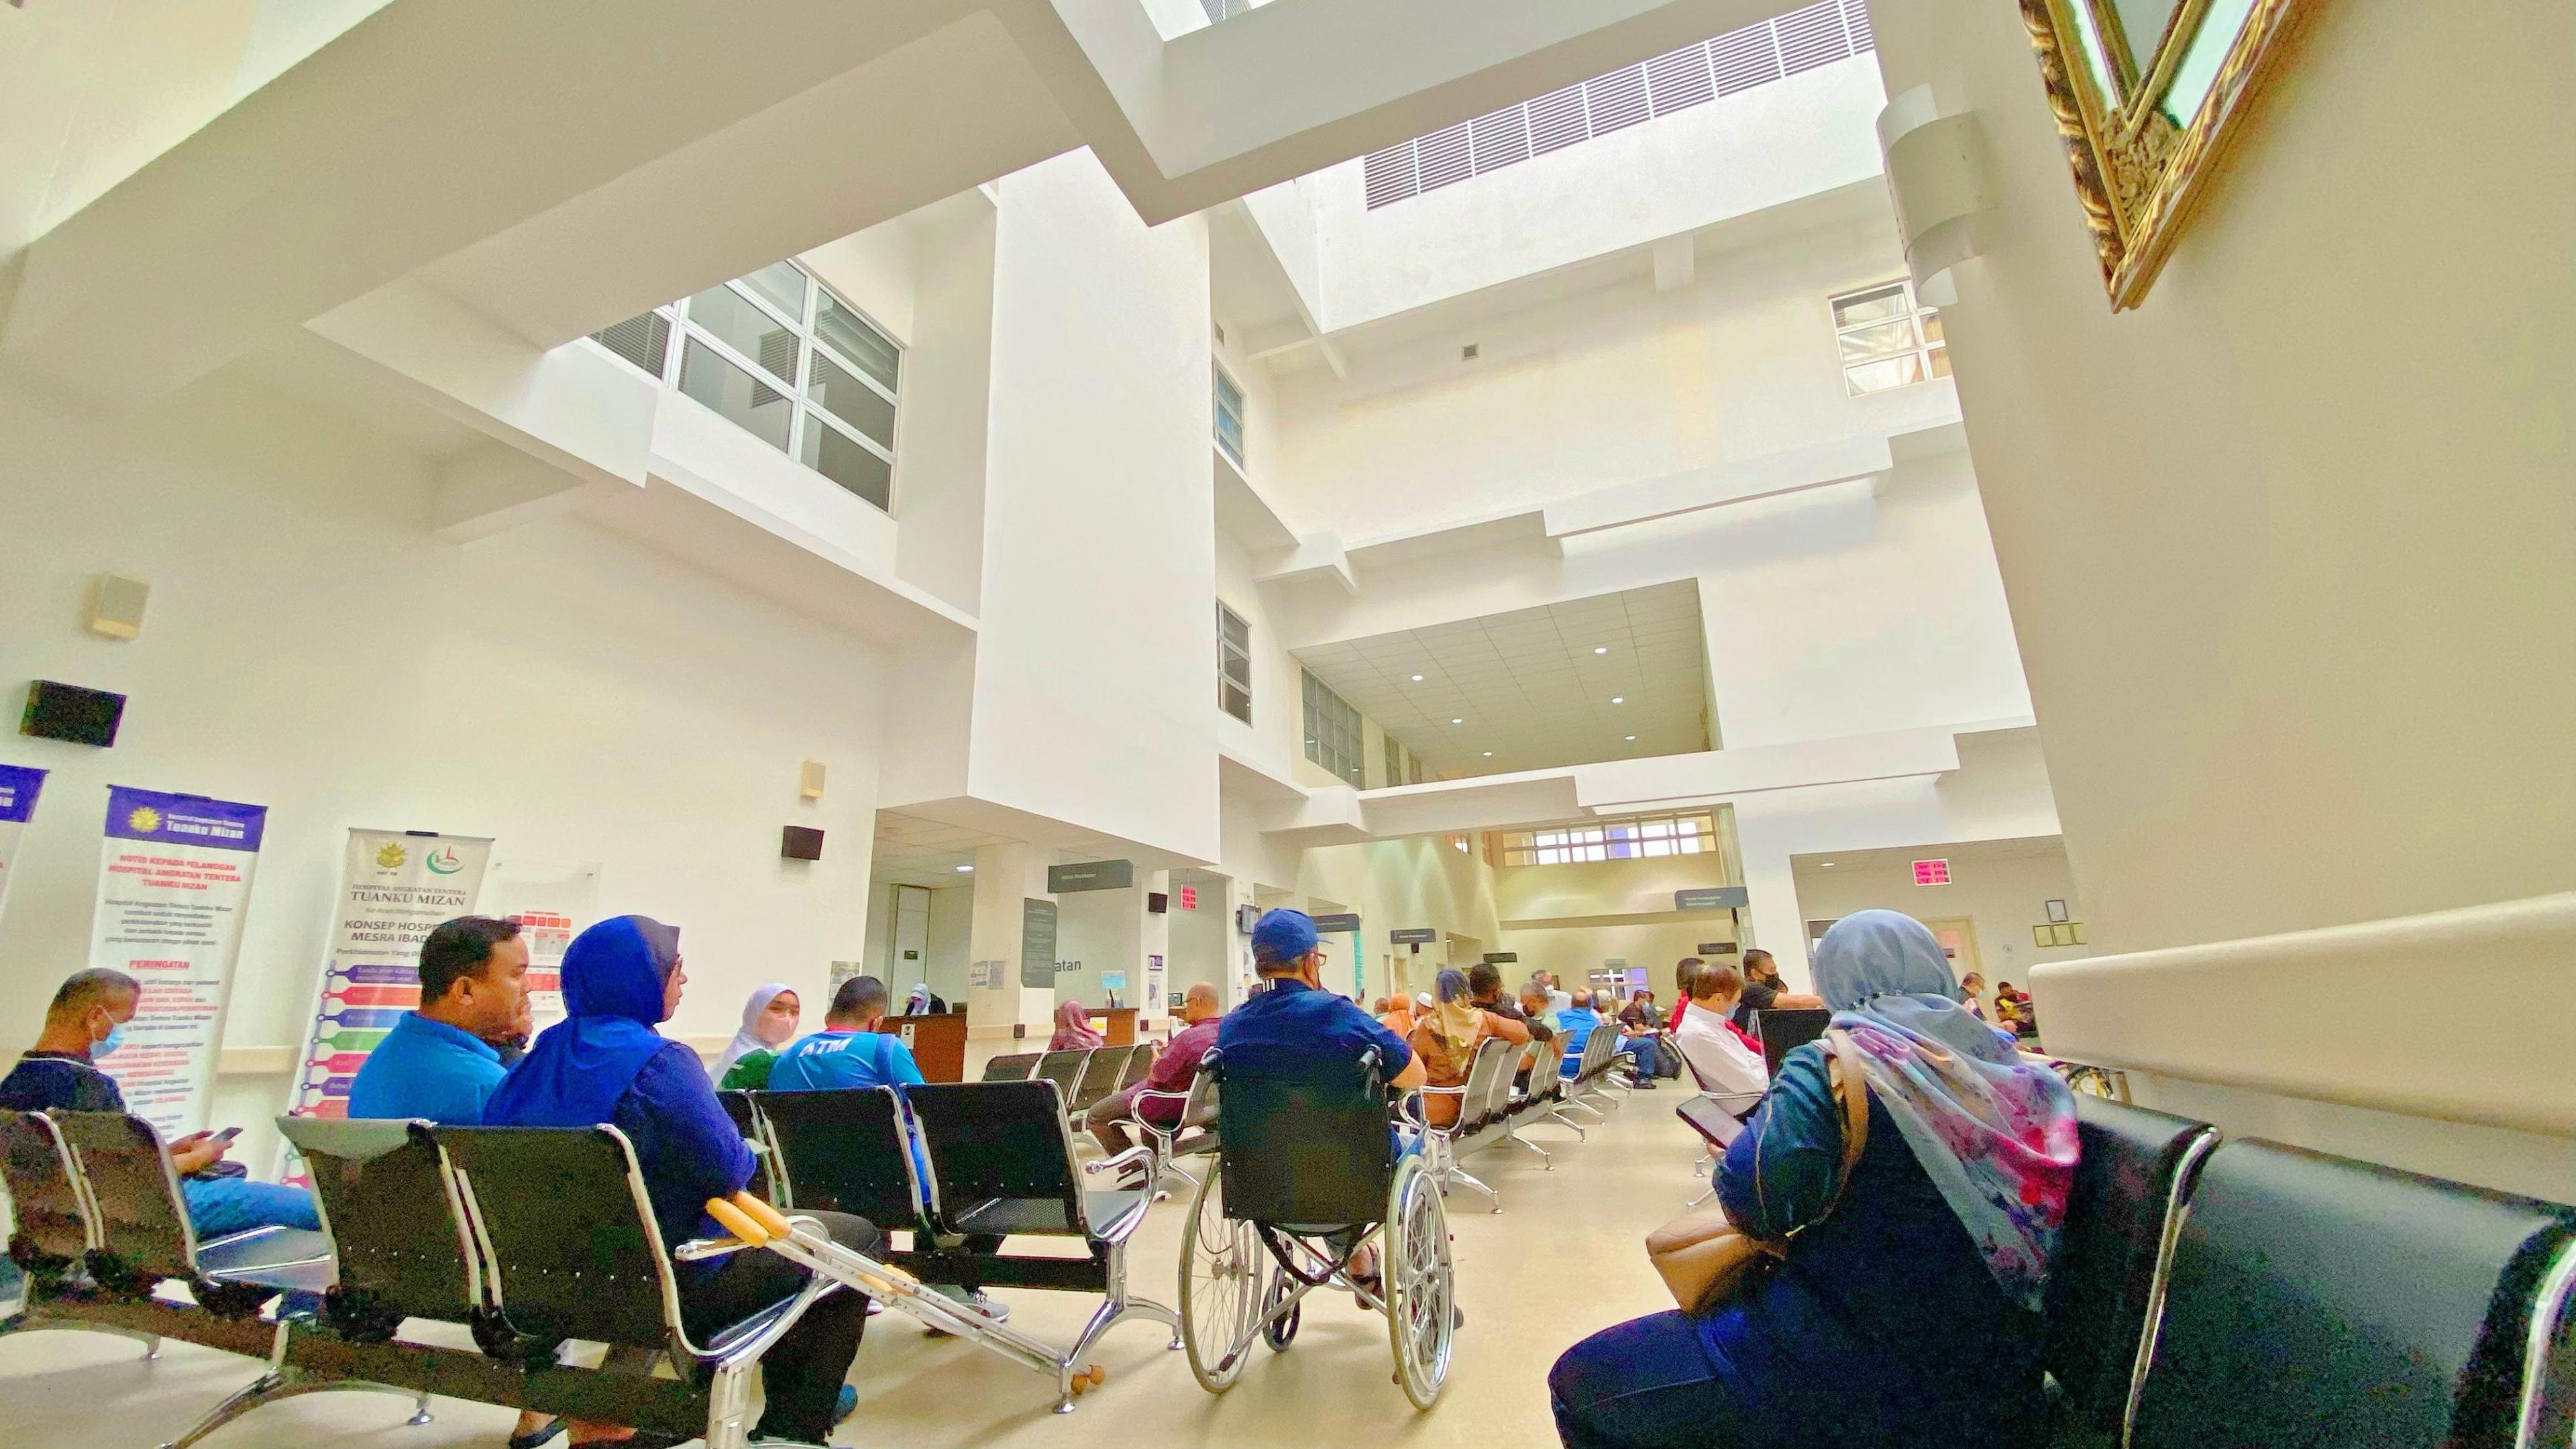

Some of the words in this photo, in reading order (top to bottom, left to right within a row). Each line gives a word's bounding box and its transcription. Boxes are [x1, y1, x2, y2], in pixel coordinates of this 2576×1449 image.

[109, 865, 153, 875] HOSPITAL
[351, 891, 413, 903] TUANKU
[417, 894, 465, 906] MIZAN
[344, 920, 395, 930] KONSEP
[351, 932, 394, 941] MESRA
[798, 1037, 853, 1057] ATM
